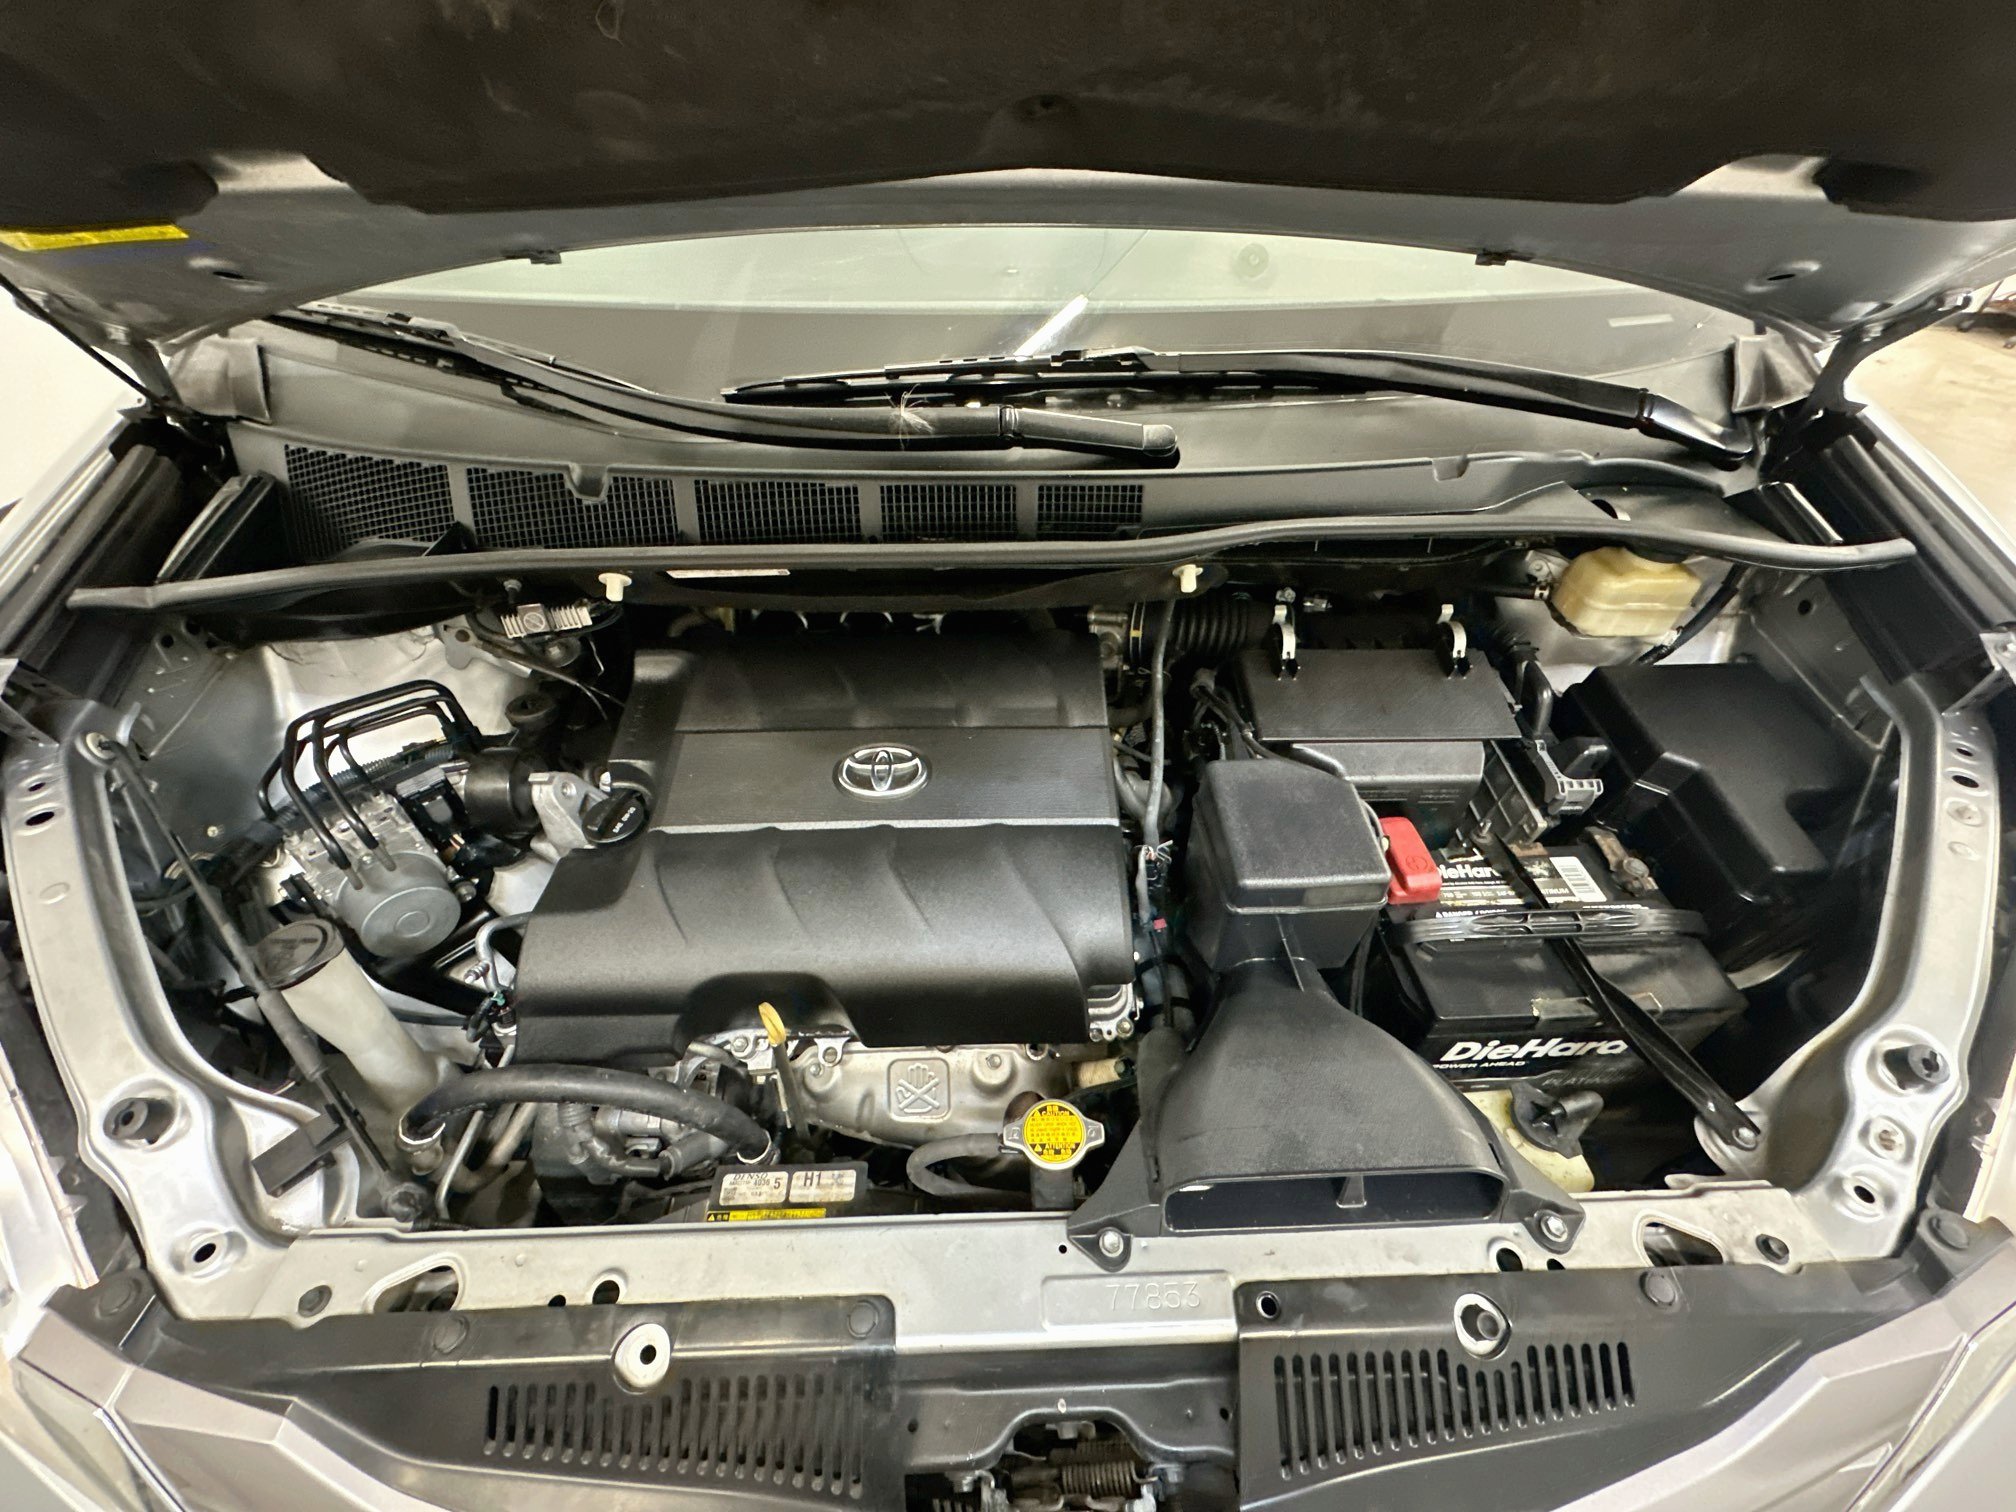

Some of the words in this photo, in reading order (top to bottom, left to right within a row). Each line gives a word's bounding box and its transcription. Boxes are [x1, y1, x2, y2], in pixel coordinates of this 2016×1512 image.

[773, 1177, 783, 1190] 5
[803, 1171, 822, 1187] H1
[1105, 1281, 1201, 1311] 77853
